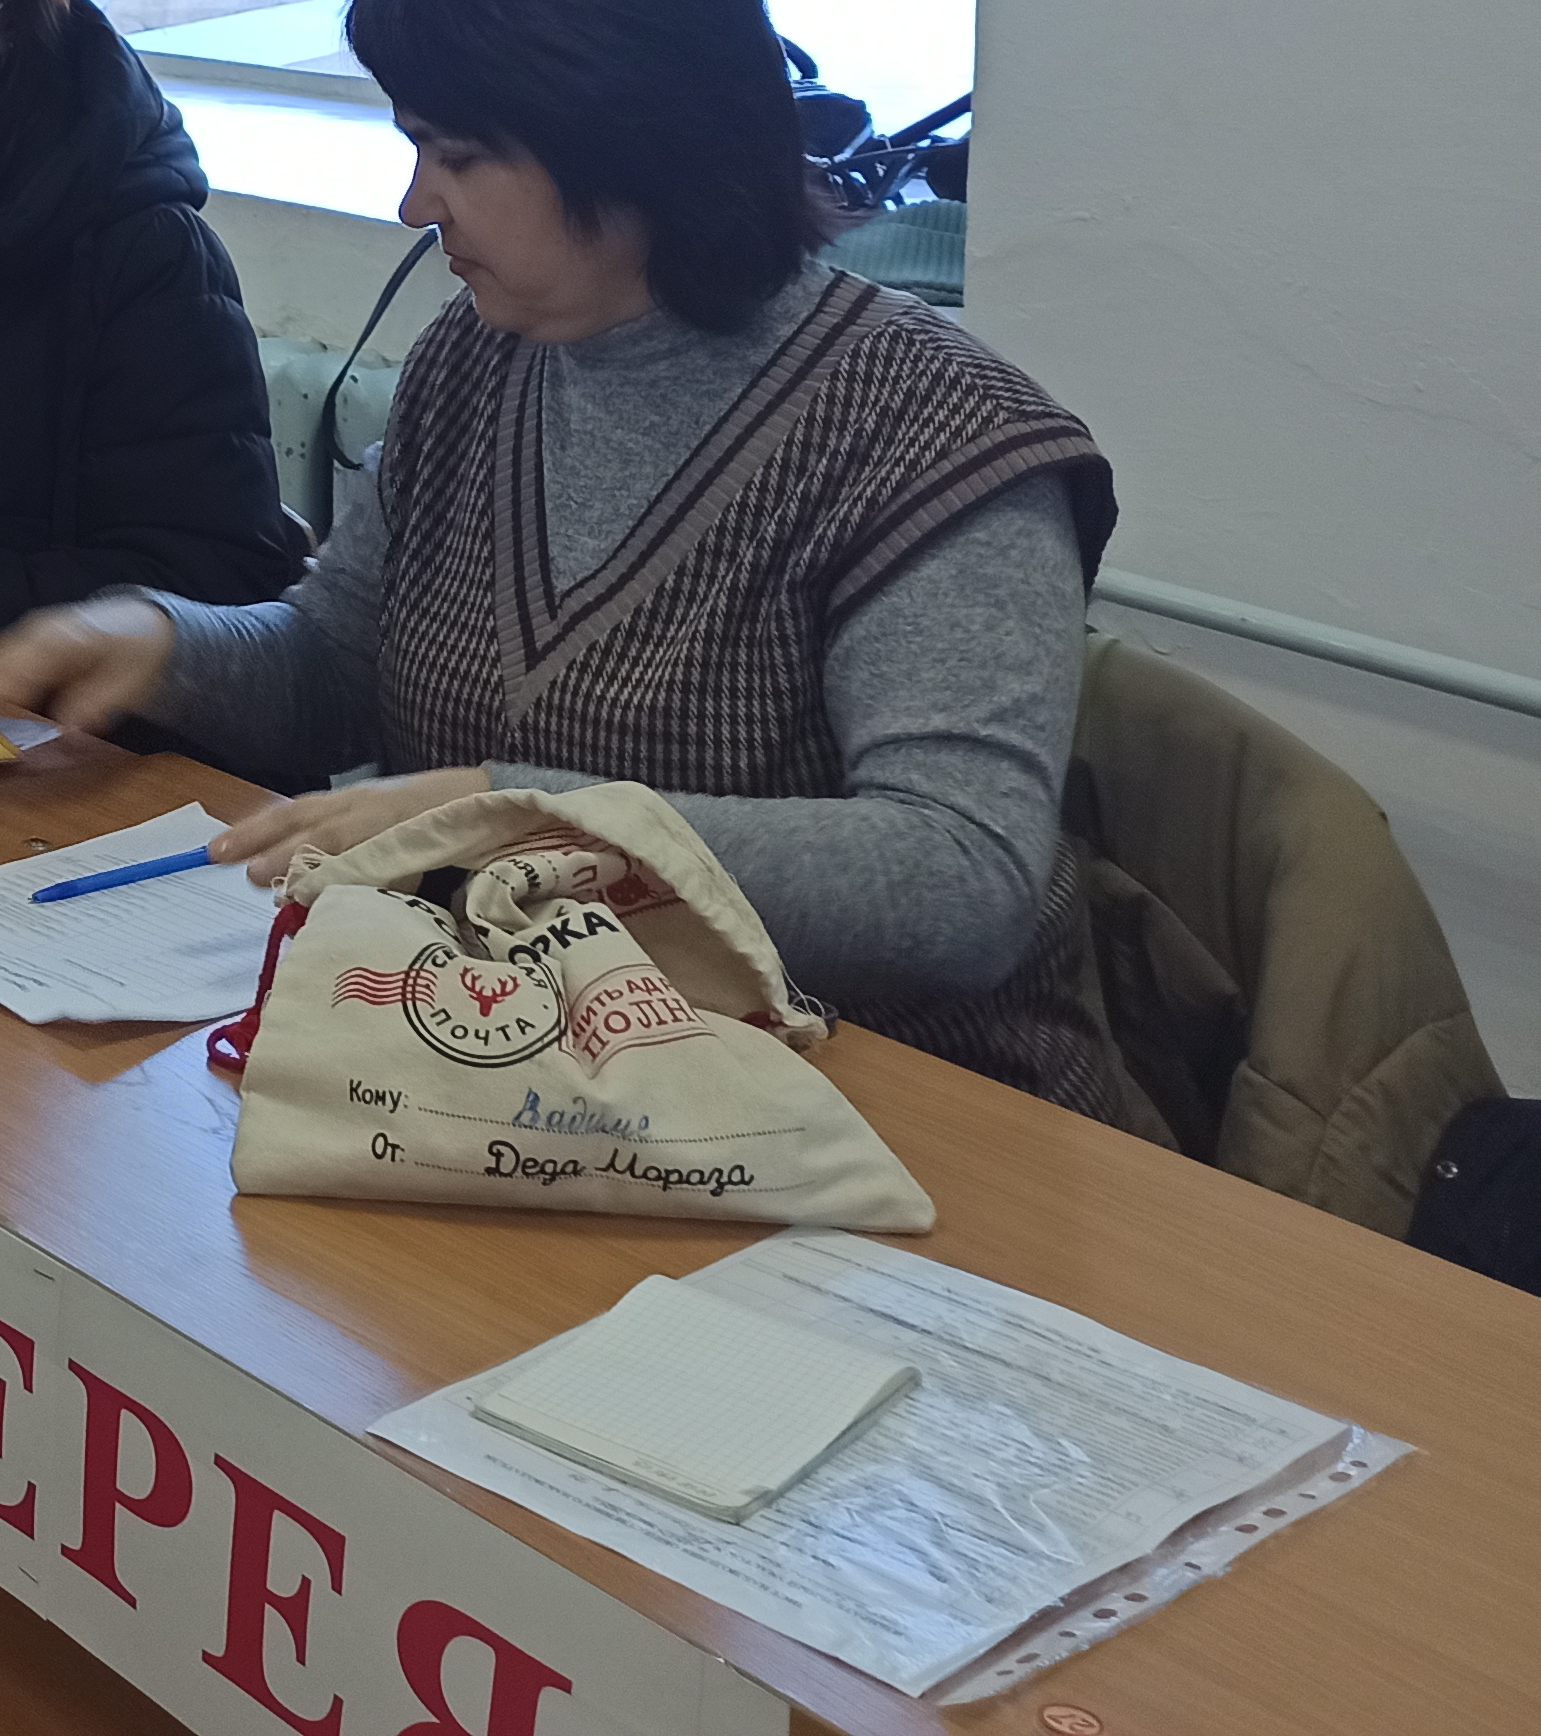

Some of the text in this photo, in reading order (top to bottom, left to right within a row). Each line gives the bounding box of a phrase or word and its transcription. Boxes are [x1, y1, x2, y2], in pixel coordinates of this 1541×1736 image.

[429, 1008, 537, 1047] ПОЧТА
[581, 997, 697, 1061] ПОЛН
[349, 1078, 410, 1114] Кому:
[371, 1132, 406, 1163] От:
[484, 1139, 755, 1197] Деда Мороза
